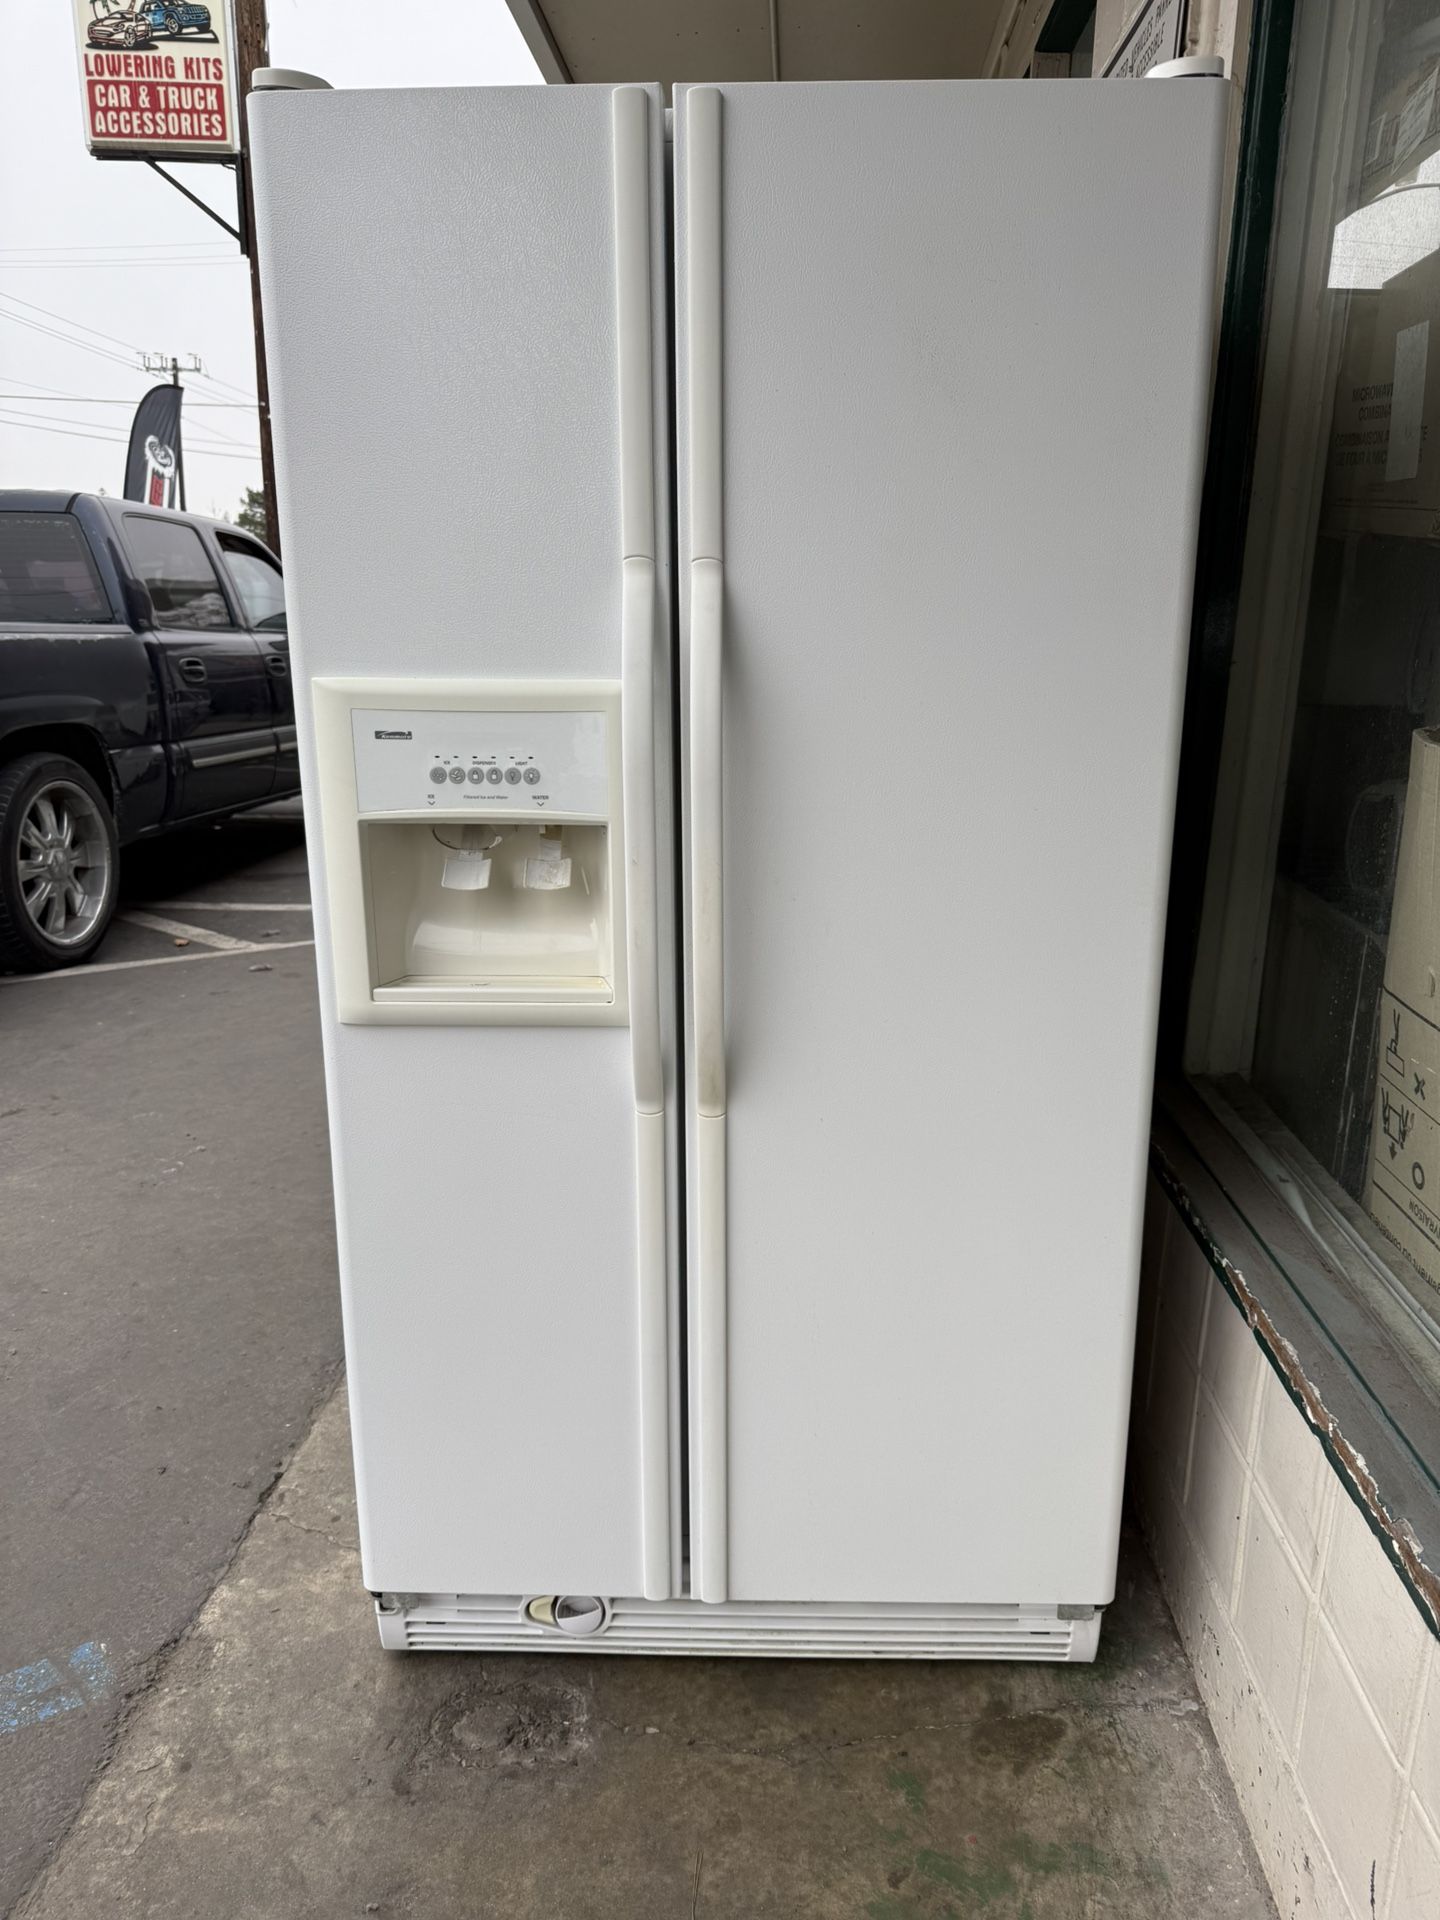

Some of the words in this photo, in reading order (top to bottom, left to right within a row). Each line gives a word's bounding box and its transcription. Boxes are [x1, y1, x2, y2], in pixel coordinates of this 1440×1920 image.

[84, 53, 175, 79] LOWERING
[184, 57, 223, 81] KITS
[95, 84, 131, 108] CAR
[138, 86, 150, 108] &
[157, 86, 218, 111] TRUCK
[95, 111, 223, 136] ACCESSORIES
